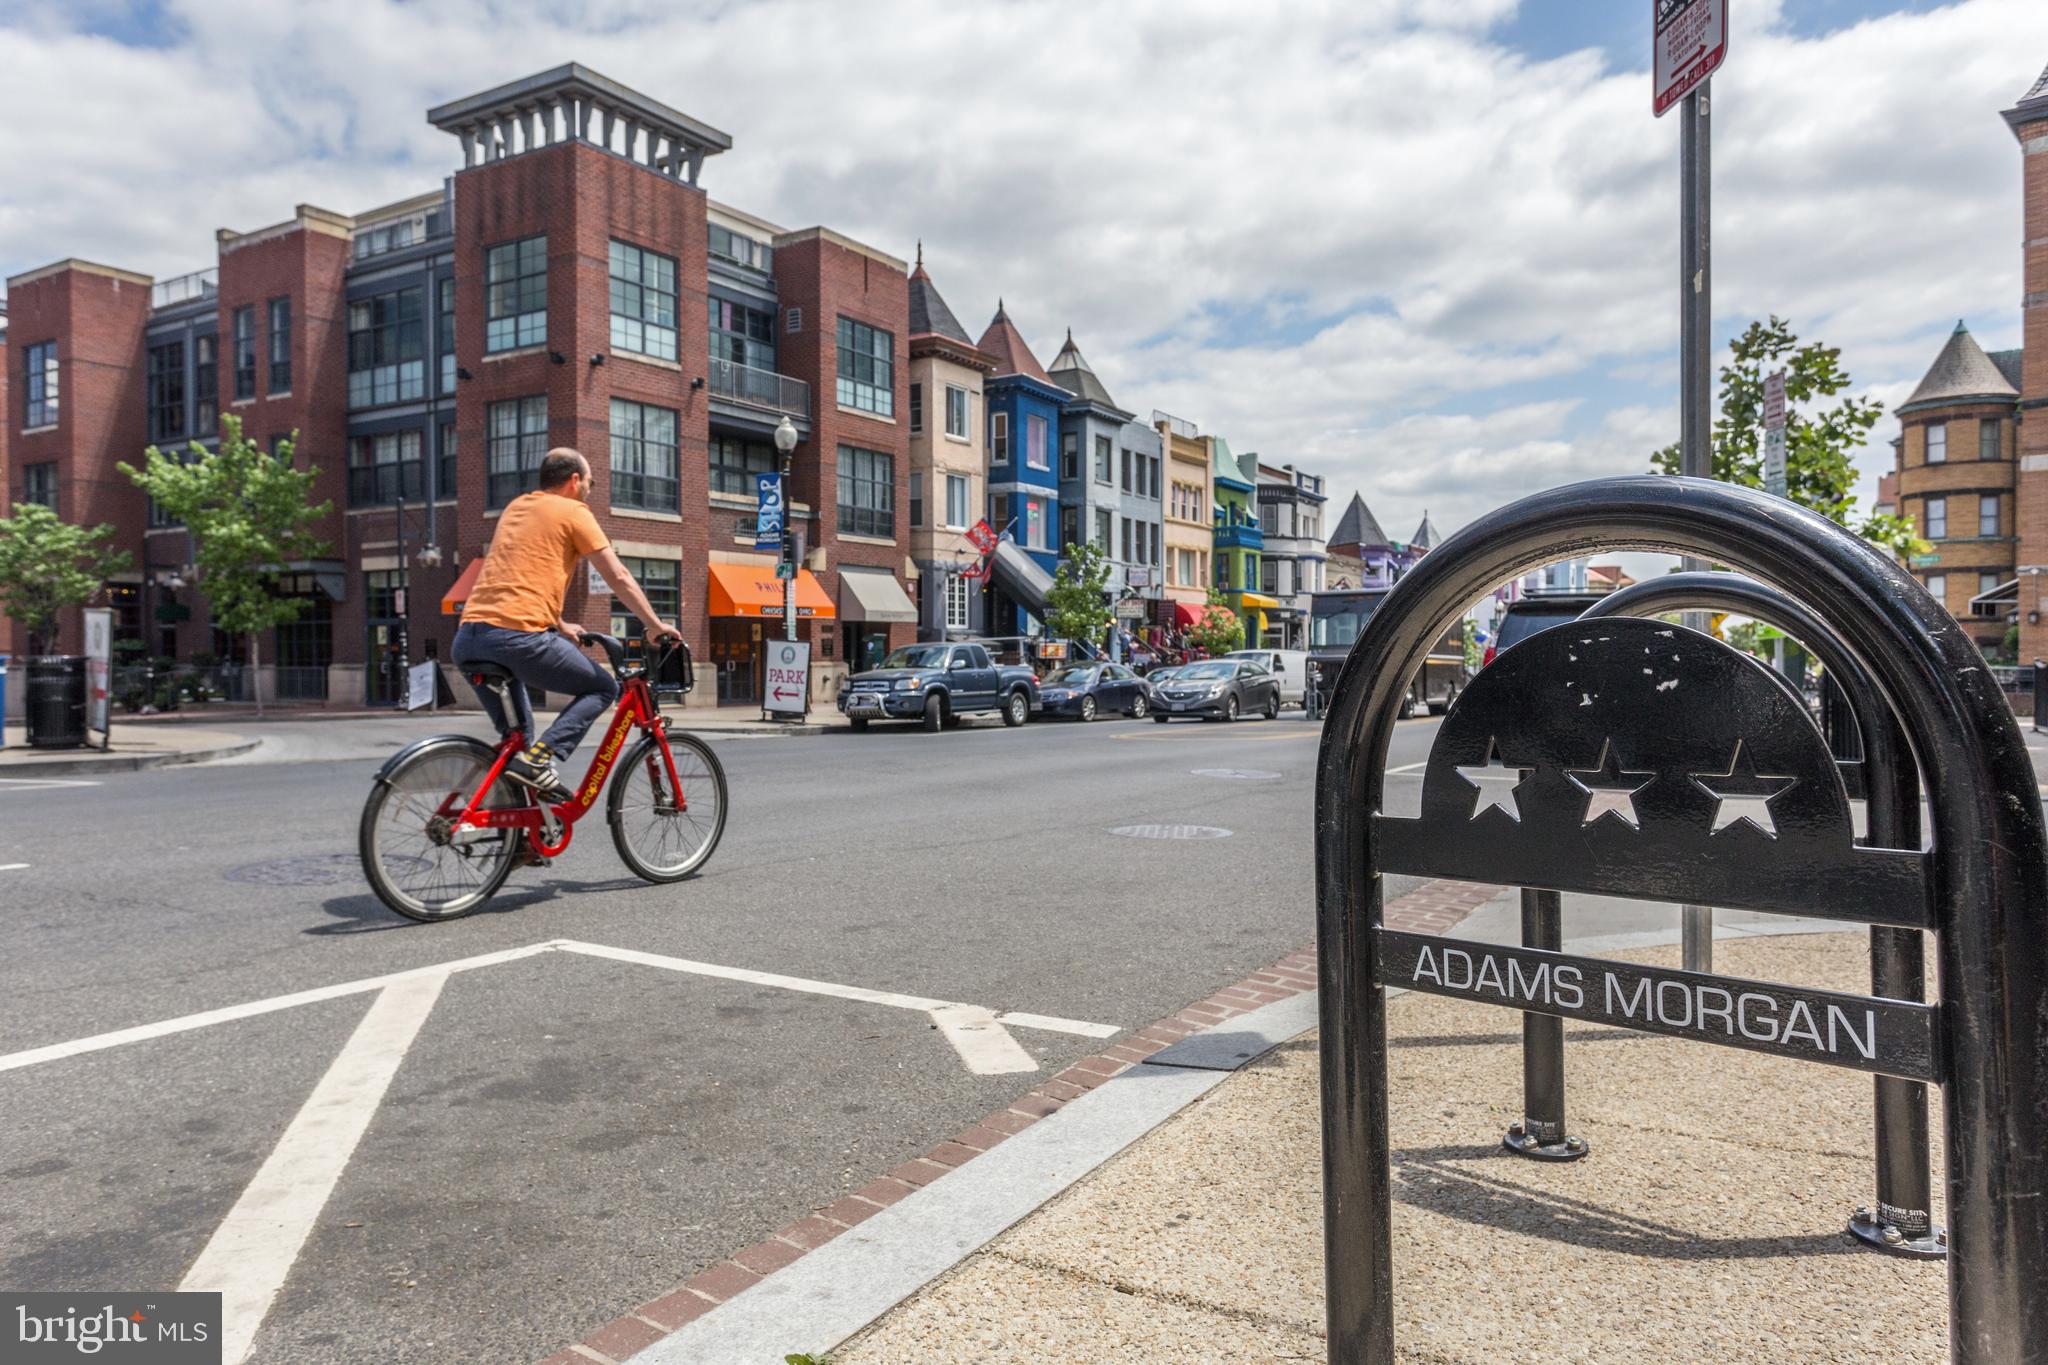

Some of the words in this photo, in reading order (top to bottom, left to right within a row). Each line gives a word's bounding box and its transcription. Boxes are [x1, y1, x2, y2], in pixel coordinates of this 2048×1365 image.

[1673, 30, 1705, 64] SATURDAY
[1690, 62, 1704, 84] CALL
[760, 478, 781, 531] SHOP
[769, 668, 805, 685] PARK
[581, 763, 607, 806] capital
[599, 710, 634, 762] bikeshare
[1412, 944, 1585, 1010] ADAMS
[1604, 971, 1877, 1060] MORGAN
